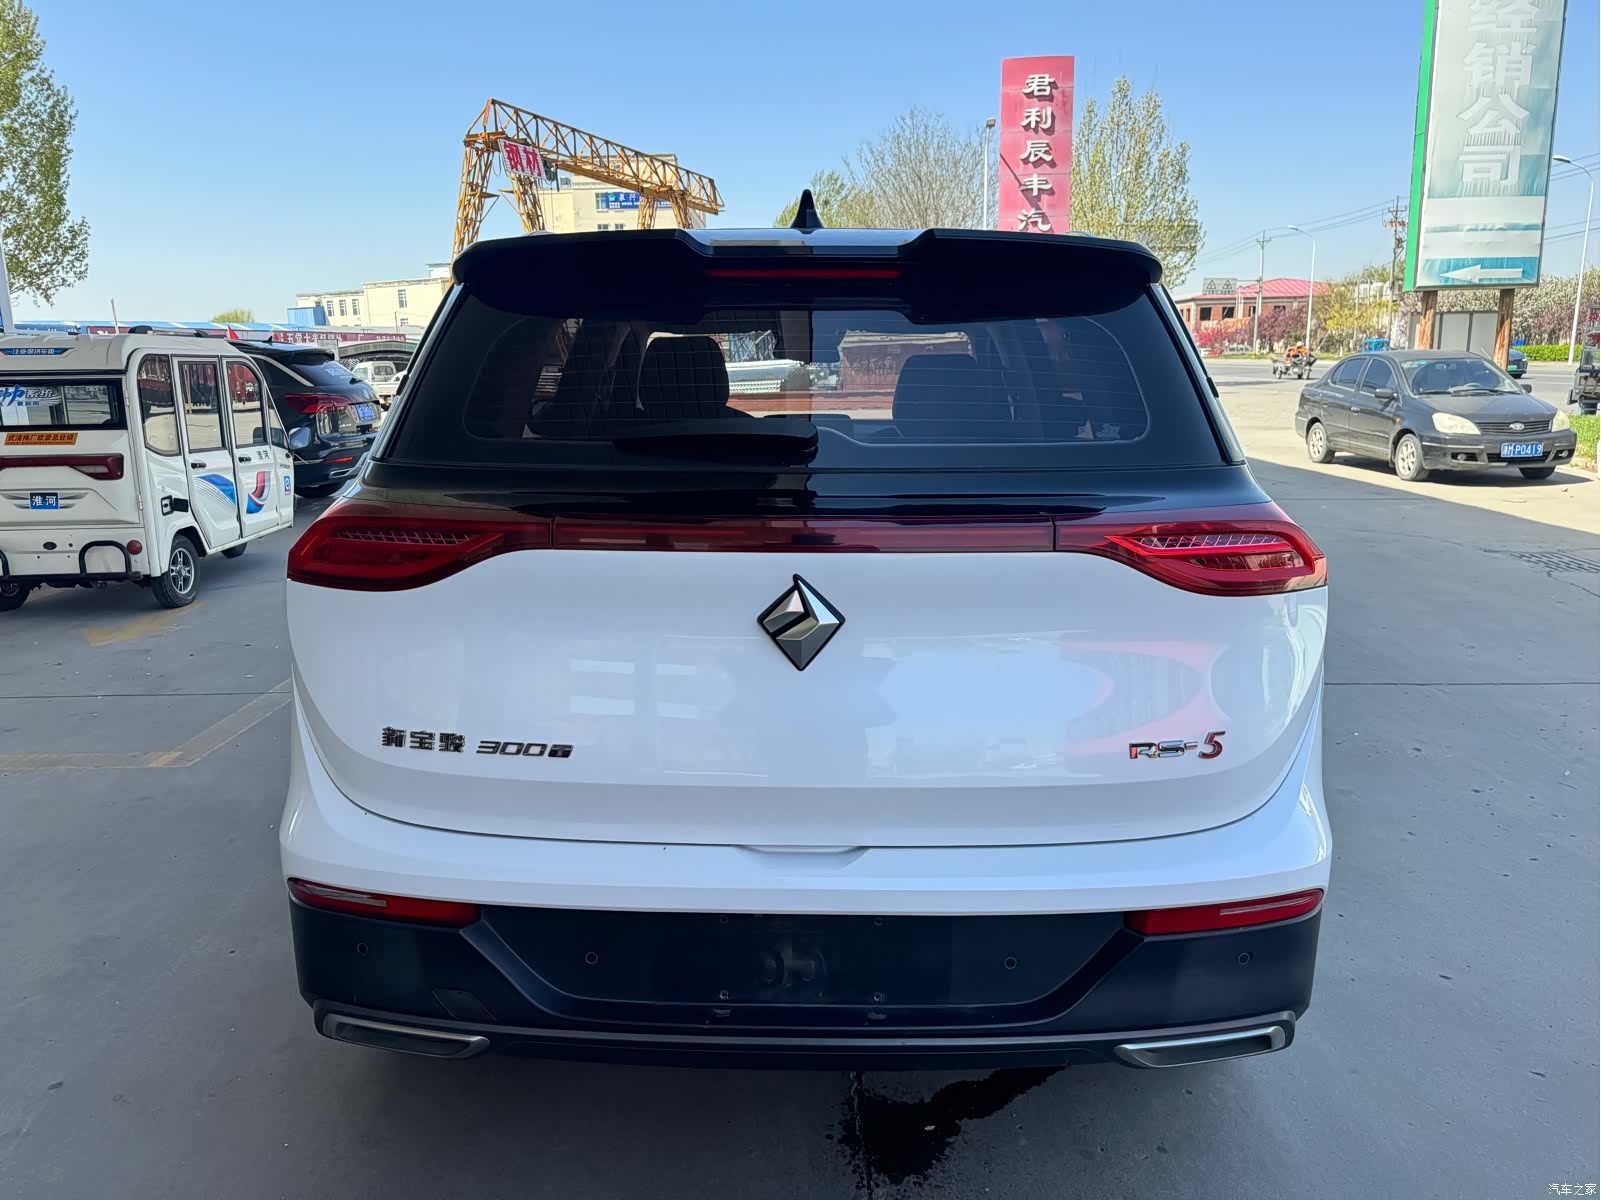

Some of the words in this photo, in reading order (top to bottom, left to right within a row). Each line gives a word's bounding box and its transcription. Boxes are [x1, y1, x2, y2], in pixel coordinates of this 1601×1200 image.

[1456, 0, 1541, 185] 经销公司
[503, 141, 542, 177] 钢材
[1017, 74, 1056, 232] 君利辰丰汽
[32, 495, 57, 506] 淮河
[381, 726, 465, 753] 新宝骏
[476, 740, 574, 758] 300T
[1128, 730, 1226, 759] RS-5
